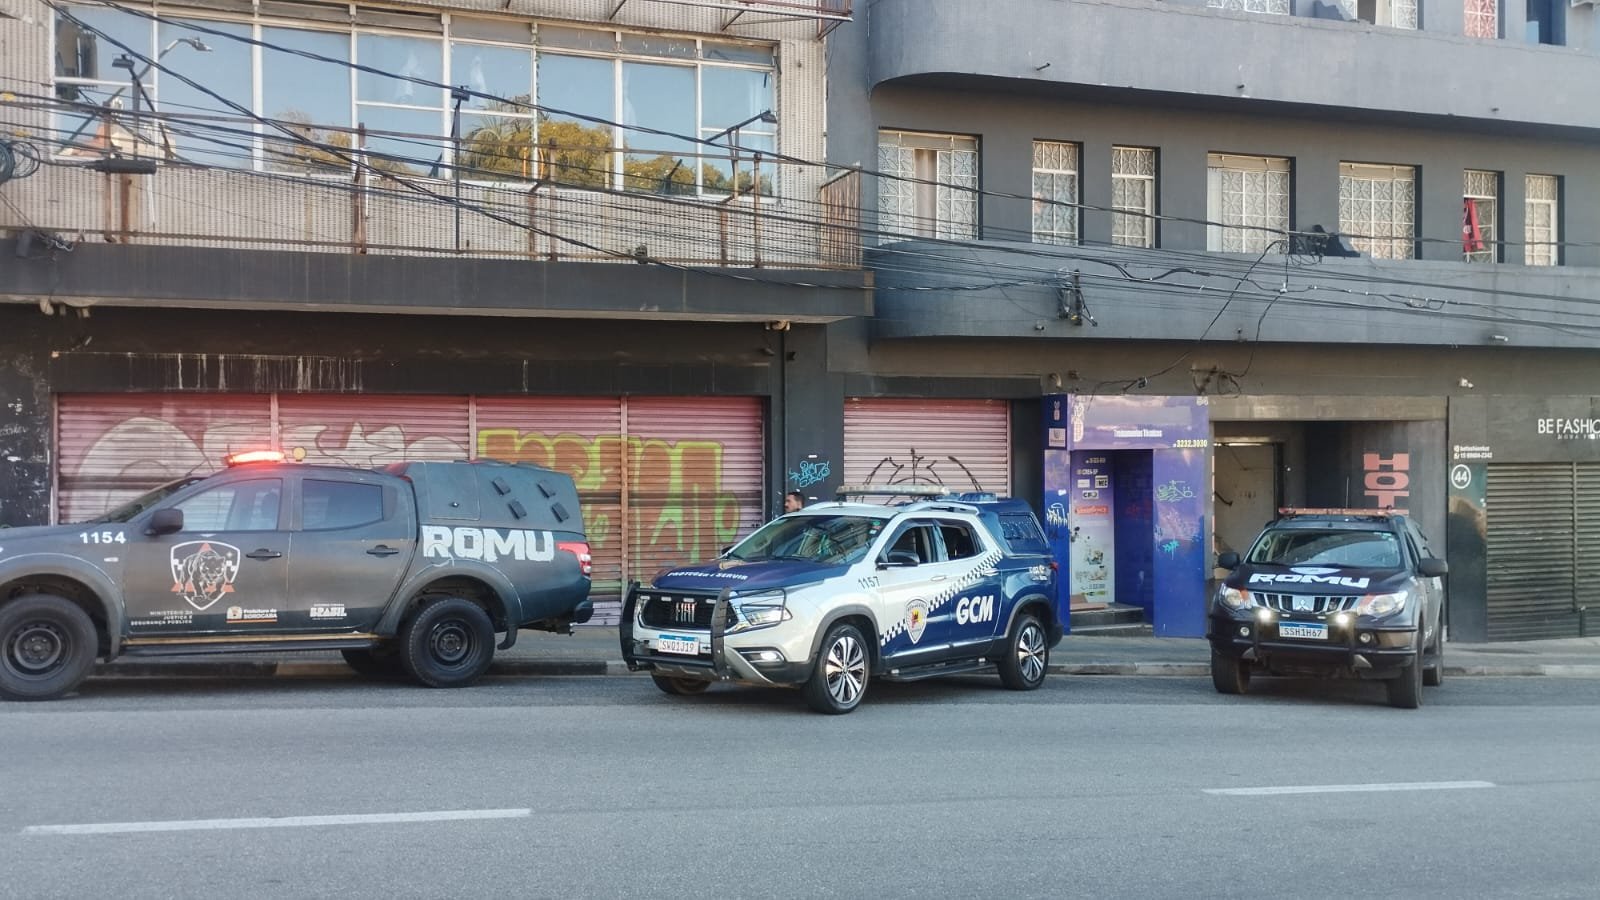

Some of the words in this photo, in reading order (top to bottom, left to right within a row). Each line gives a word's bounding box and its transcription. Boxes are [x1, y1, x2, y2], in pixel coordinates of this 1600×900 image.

[1538, 418, 1554, 434] BE
[1454, 470, 1468, 483] 44
[1363, 453, 1409, 515] HOT
[79, 531, 127, 544] 1154
[422, 525, 555, 562] ROMU
[715, 572, 749, 580] SERVIR
[858, 576, 880, 589] 1157
[1249, 573, 1370, 589] ROMU
[309, 607, 348, 617] BRASIL
[675, 602, 697, 623] FIAT
[956, 595, 994, 625] GCM
[1284, 628, 1322, 637] SSH1H67
